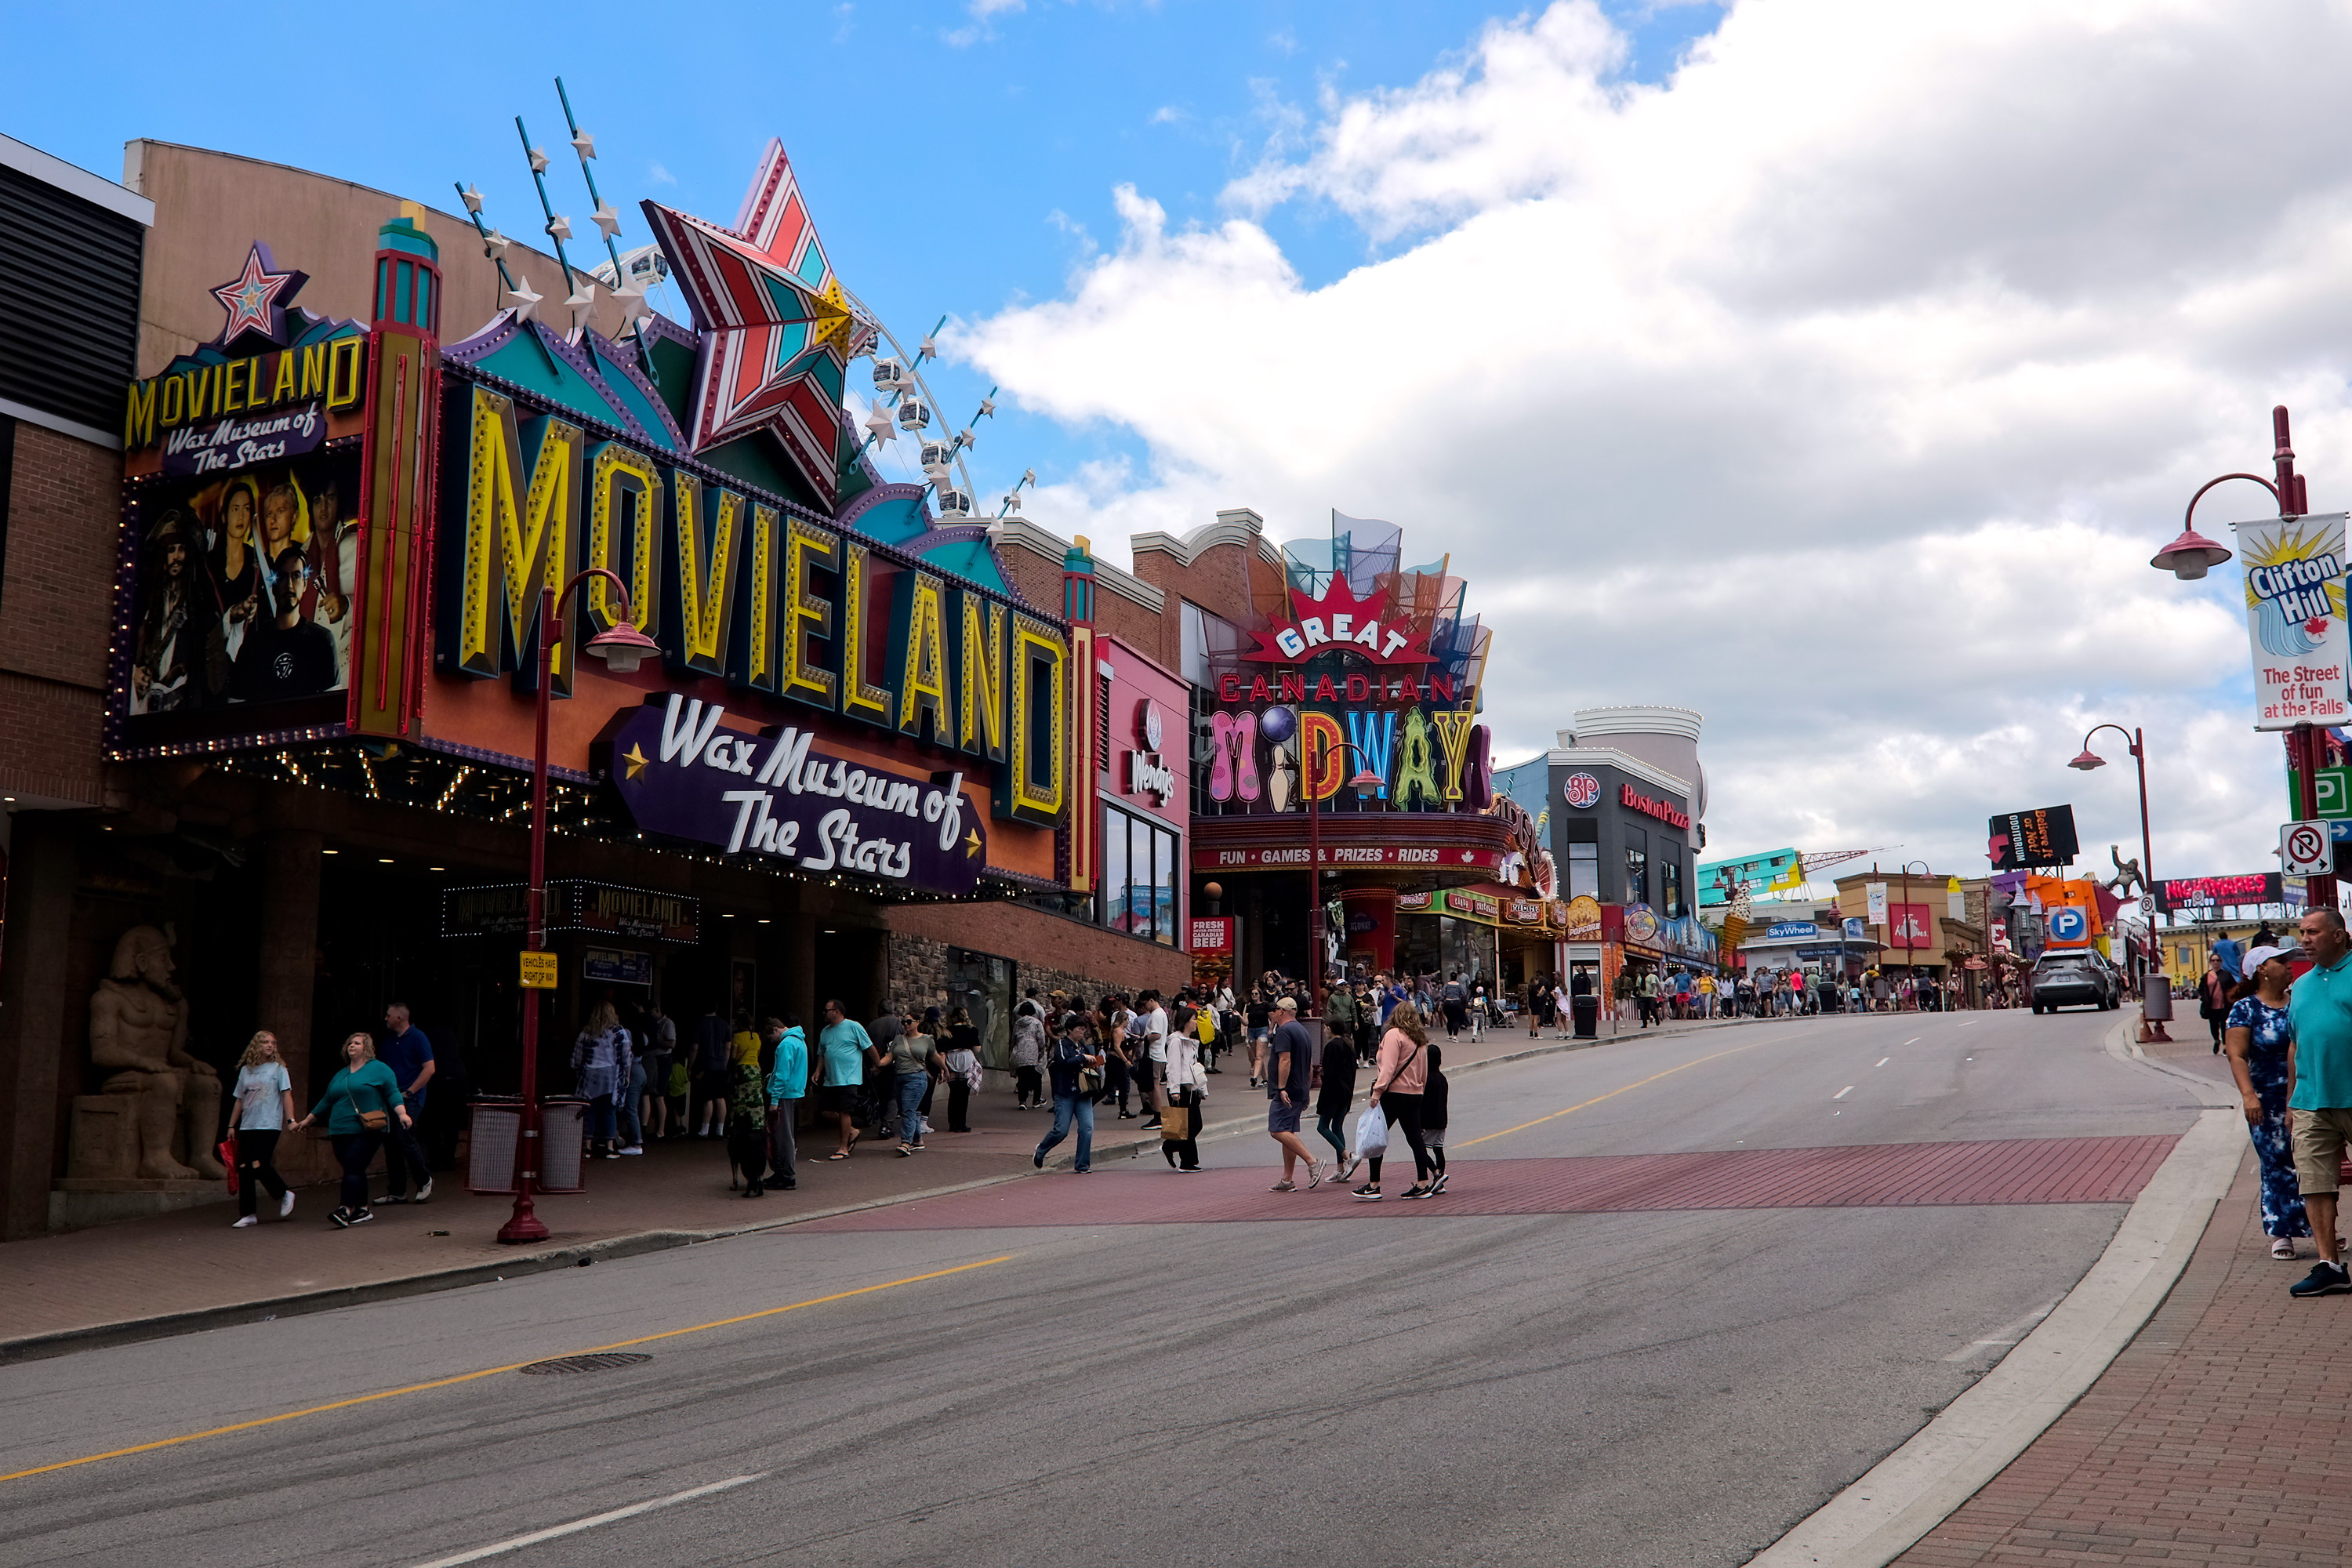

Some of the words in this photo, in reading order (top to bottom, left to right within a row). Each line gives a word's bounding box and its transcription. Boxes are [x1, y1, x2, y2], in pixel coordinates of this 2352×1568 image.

[124, 335, 365, 452] MOVIELAND
[167, 426, 209, 456] Wax
[208, 414, 291, 447] Museum
[292, 401, 318, 437] of
[193, 448, 227, 474] The
[228, 440, 286, 470] Stars
[2250, 553, 2339, 600] Clifton
[458, 383, 1069, 831] MOVIELAND
[2278, 586, 2331, 625] Hill
[1276, 613, 1409, 659] GREAT
[1219, 673, 1454, 702] CANADIAN
[2263, 668, 2290, 684] The
[2294, 665, 2340, 683] Street
[2281, 684, 2296, 701] of
[2299, 684, 2324, 699] fun
[2264, 703, 2279, 719] at
[2282, 702, 2307, 717] the
[2310, 699, 2344, 716] Falls
[659, 692, 757, 776] Wax
[755, 726, 920, 818] Museum
[923, 771, 965, 852] of
[1131, 749, 1174, 808] Wendy's
[1569, 777, 1599, 804] BP
[721, 789, 800, 855] The
[800, 808, 912, 879] Stars
[2024, 817, 2034, 830] or
[2034, 810, 2049, 847] Believe
[2042, 848, 2054, 858] It
[2009, 815, 2026, 862] ODDITORIUM
[2025, 830, 2041, 855] Not!
[1219, 851, 1246, 865] FUN
[1261, 848, 1311, 863] GAMES
[1317, 849, 1327, 862] &
[1334, 848, 1384, 862] PRIZES
[1397, 848, 1439, 862] RIDES
[2165, 873, 2267, 901] NIGHTMARES
[597, 888, 682, 929] MOVIELAND
[1193, 920, 1225, 929] FRESH
[1570, 922, 1600, 936] POPCORN
[1769, 925, 1813, 937] SkyWheel
[2058, 914, 2078, 933] P
[1192, 938, 1224, 948] BEEF
[523, 957, 545, 968] VEHICLES
[545, 959, 556, 969] HAVE
[524, 971, 539, 982] RIGHT
[538, 972, 545, 982] OF
[545, 973, 554, 982] WAY
